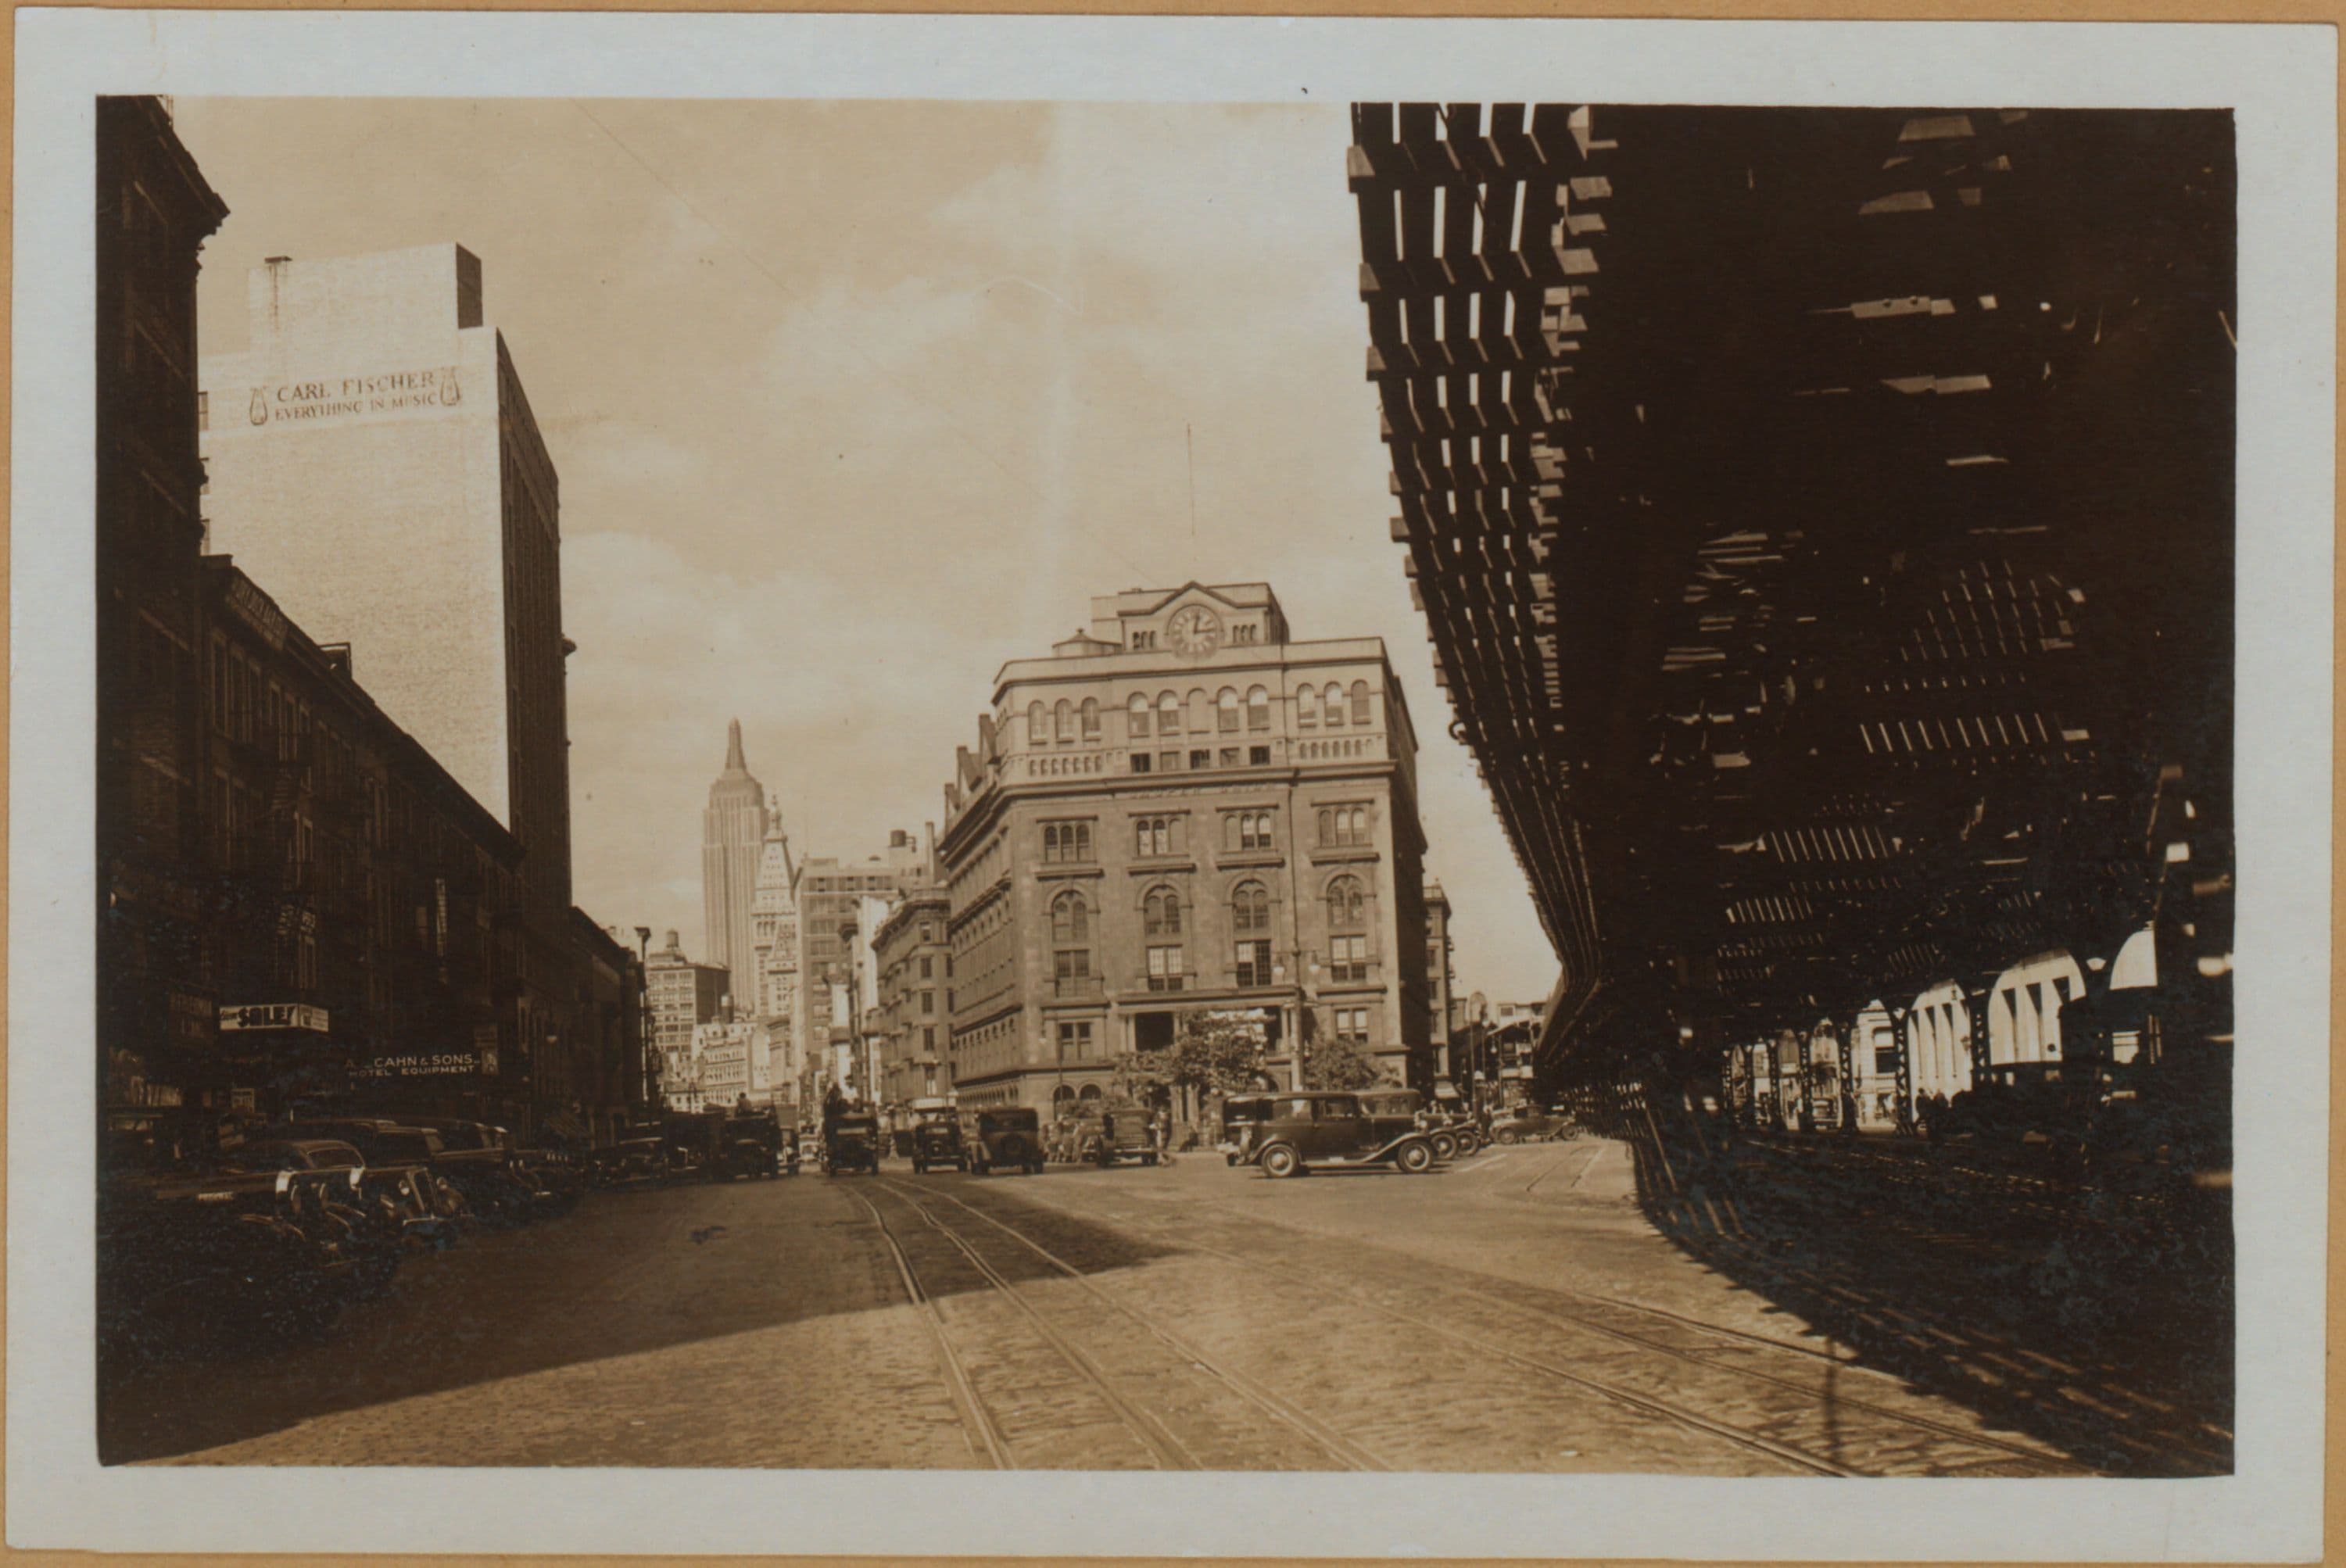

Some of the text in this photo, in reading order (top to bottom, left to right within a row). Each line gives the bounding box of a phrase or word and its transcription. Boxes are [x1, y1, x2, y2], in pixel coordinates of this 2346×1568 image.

[277, 371, 435, 403] CARL FISCHER
[275, 392, 438, 421] EVERYTHING IN MUSIC
[374, 1056, 417, 1068] CAHN
[432, 1054, 473, 1065] SONS
[401, 1065, 475, 1076] EQUIPMENT
